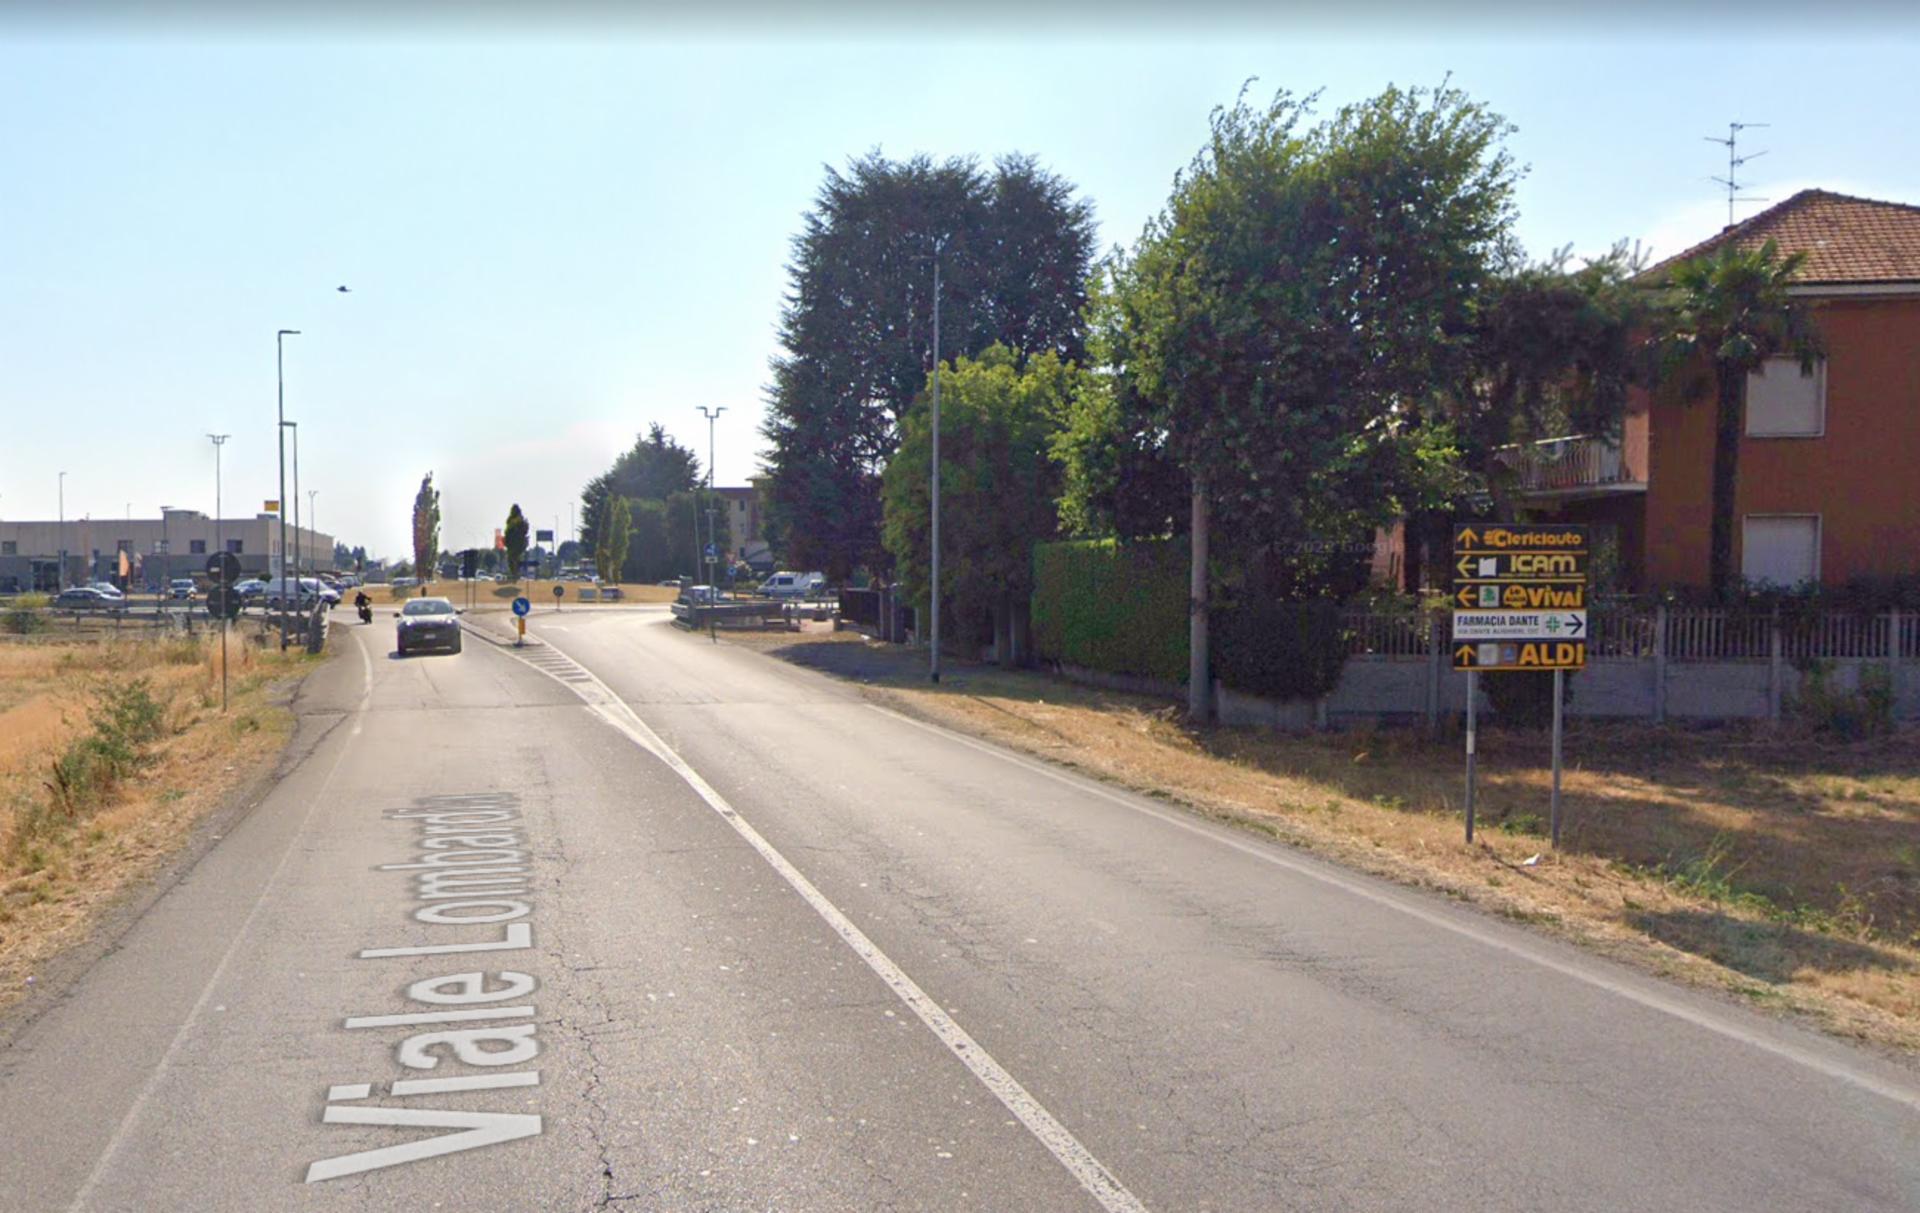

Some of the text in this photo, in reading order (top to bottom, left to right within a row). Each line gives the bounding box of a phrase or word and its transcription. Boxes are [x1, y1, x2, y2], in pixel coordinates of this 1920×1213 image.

[1494, 529, 1582, 547] Clericiauto
[1510, 555, 1576, 572] ICAM
[1457, 615, 1539, 626] FARMACIA DANTE
[1519, 643, 1585, 665] ALDI
